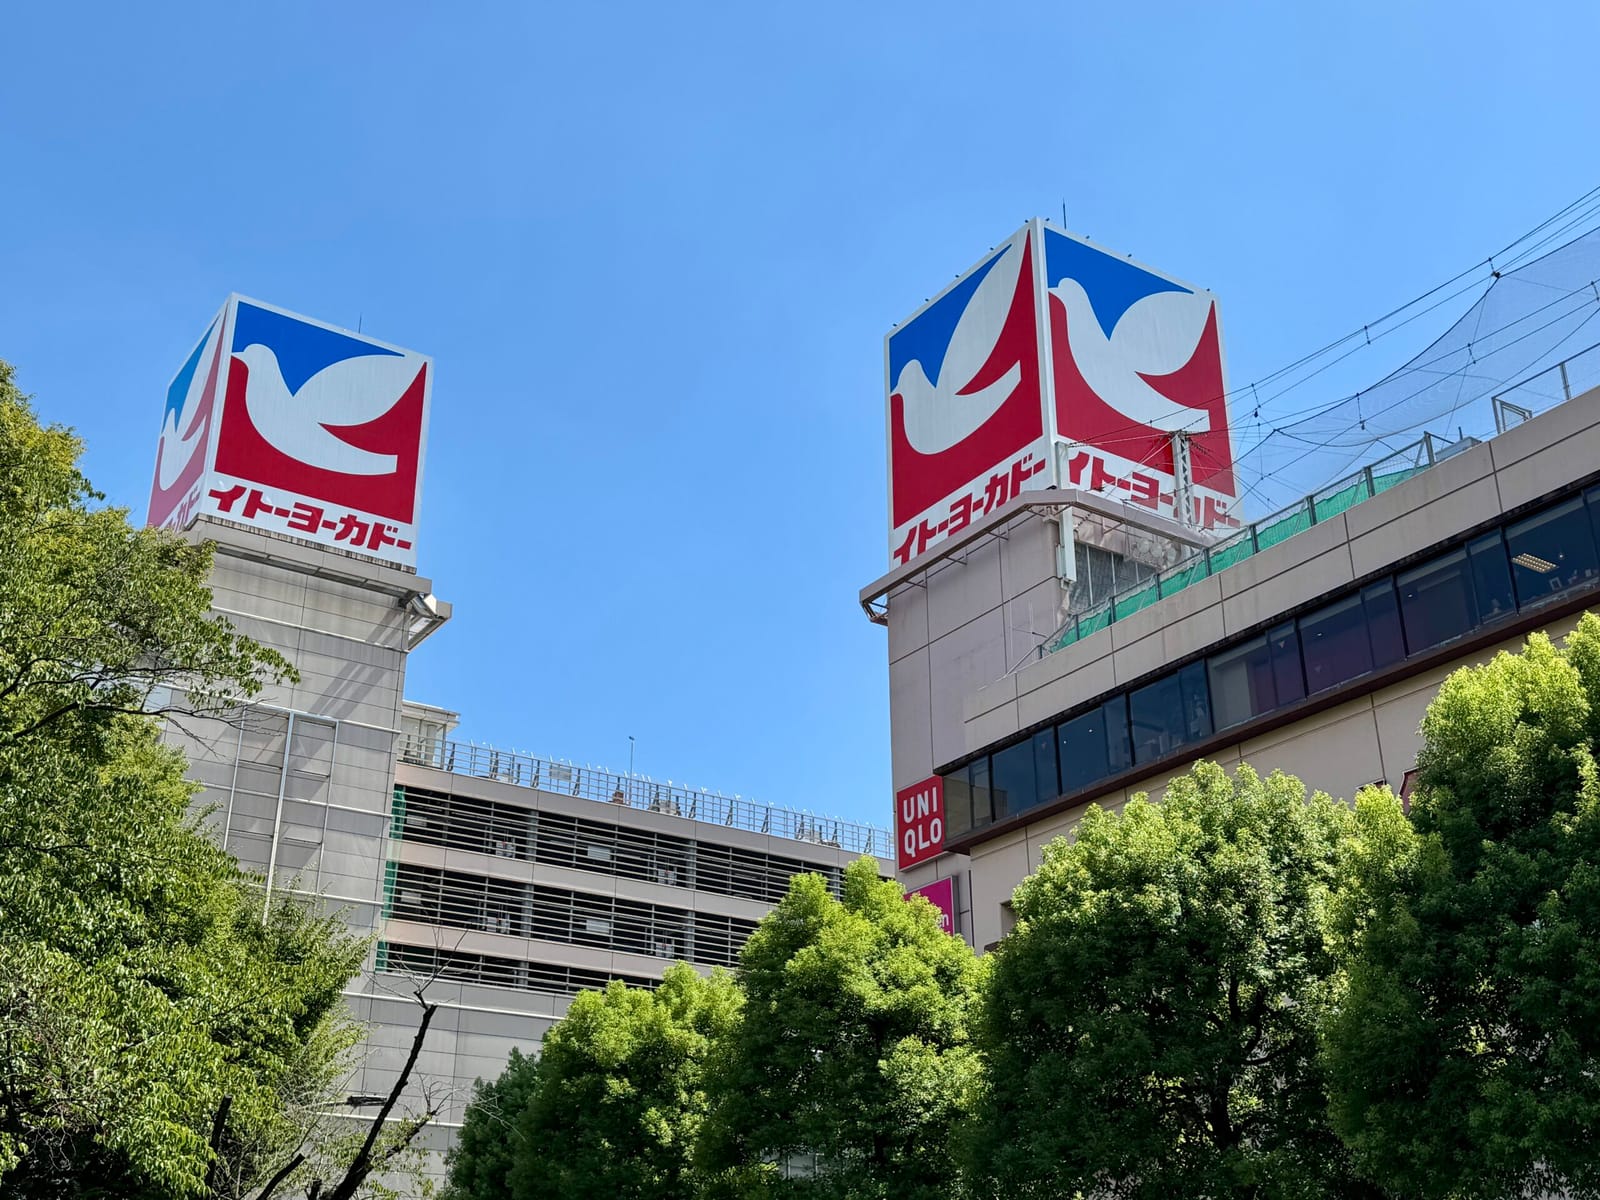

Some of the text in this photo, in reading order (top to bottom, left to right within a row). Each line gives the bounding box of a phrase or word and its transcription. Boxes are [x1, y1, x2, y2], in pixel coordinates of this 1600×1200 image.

[208, 484, 412, 551] イトーヨーカドー
[893, 453, 1046, 566] イトーヨーカドー
[903, 786, 938, 824] UNI
[903, 817, 942, 858] QLO
